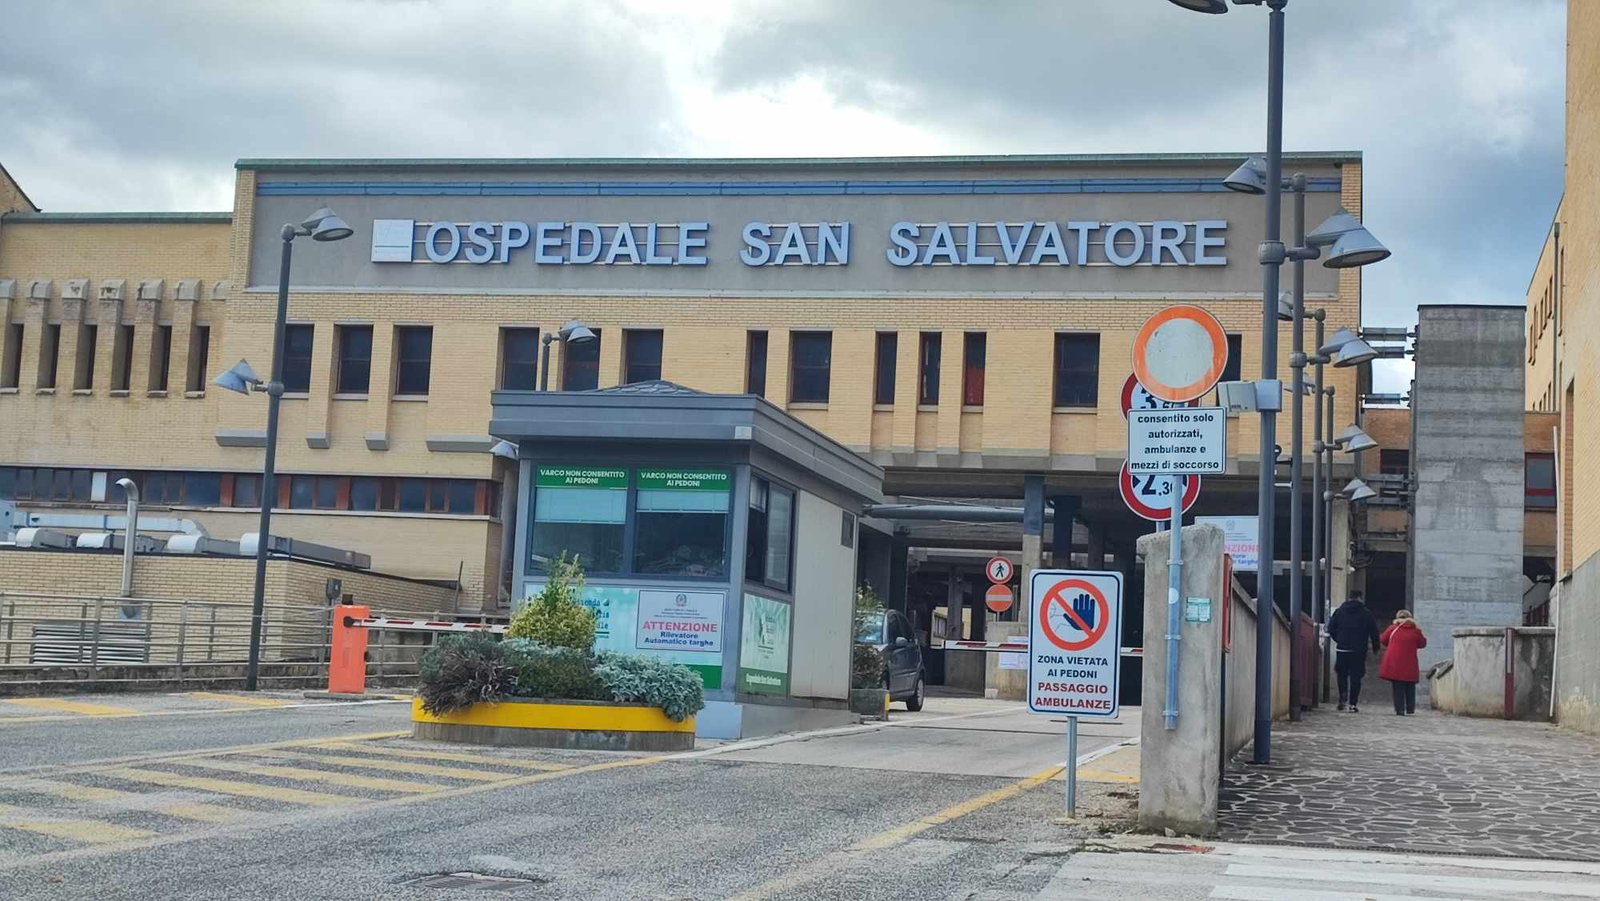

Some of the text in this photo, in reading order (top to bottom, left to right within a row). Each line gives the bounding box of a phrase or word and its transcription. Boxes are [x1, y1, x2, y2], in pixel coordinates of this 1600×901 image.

[424, 220, 1228, 267] OSPEDALE SAN SALVATORE
[1137, 413, 1214, 423] consentito solo
[1148, 429, 1203, 439] autorizzati,
[1144, 445, 1197, 454] ambulanze
[1131, 460, 1219, 470] mezzi di soccorso
[581, 470, 625, 478] CONSENTITO
[1141, 474, 1173, 496] 2,3
[642, 621, 718, 632] ATTENZIONE
[660, 631, 699, 639] Rilevatore
[644, 637, 714, 647] Automatico targhe
[1037, 655, 1064, 664] ZONA
[1066, 656, 1109, 666] VIETATA
[1047, 669, 1098, 679] AI PEDONI
[1037, 682, 1108, 694] PASSAGGIO
[1034, 697, 1111, 709] AMBULANZE
